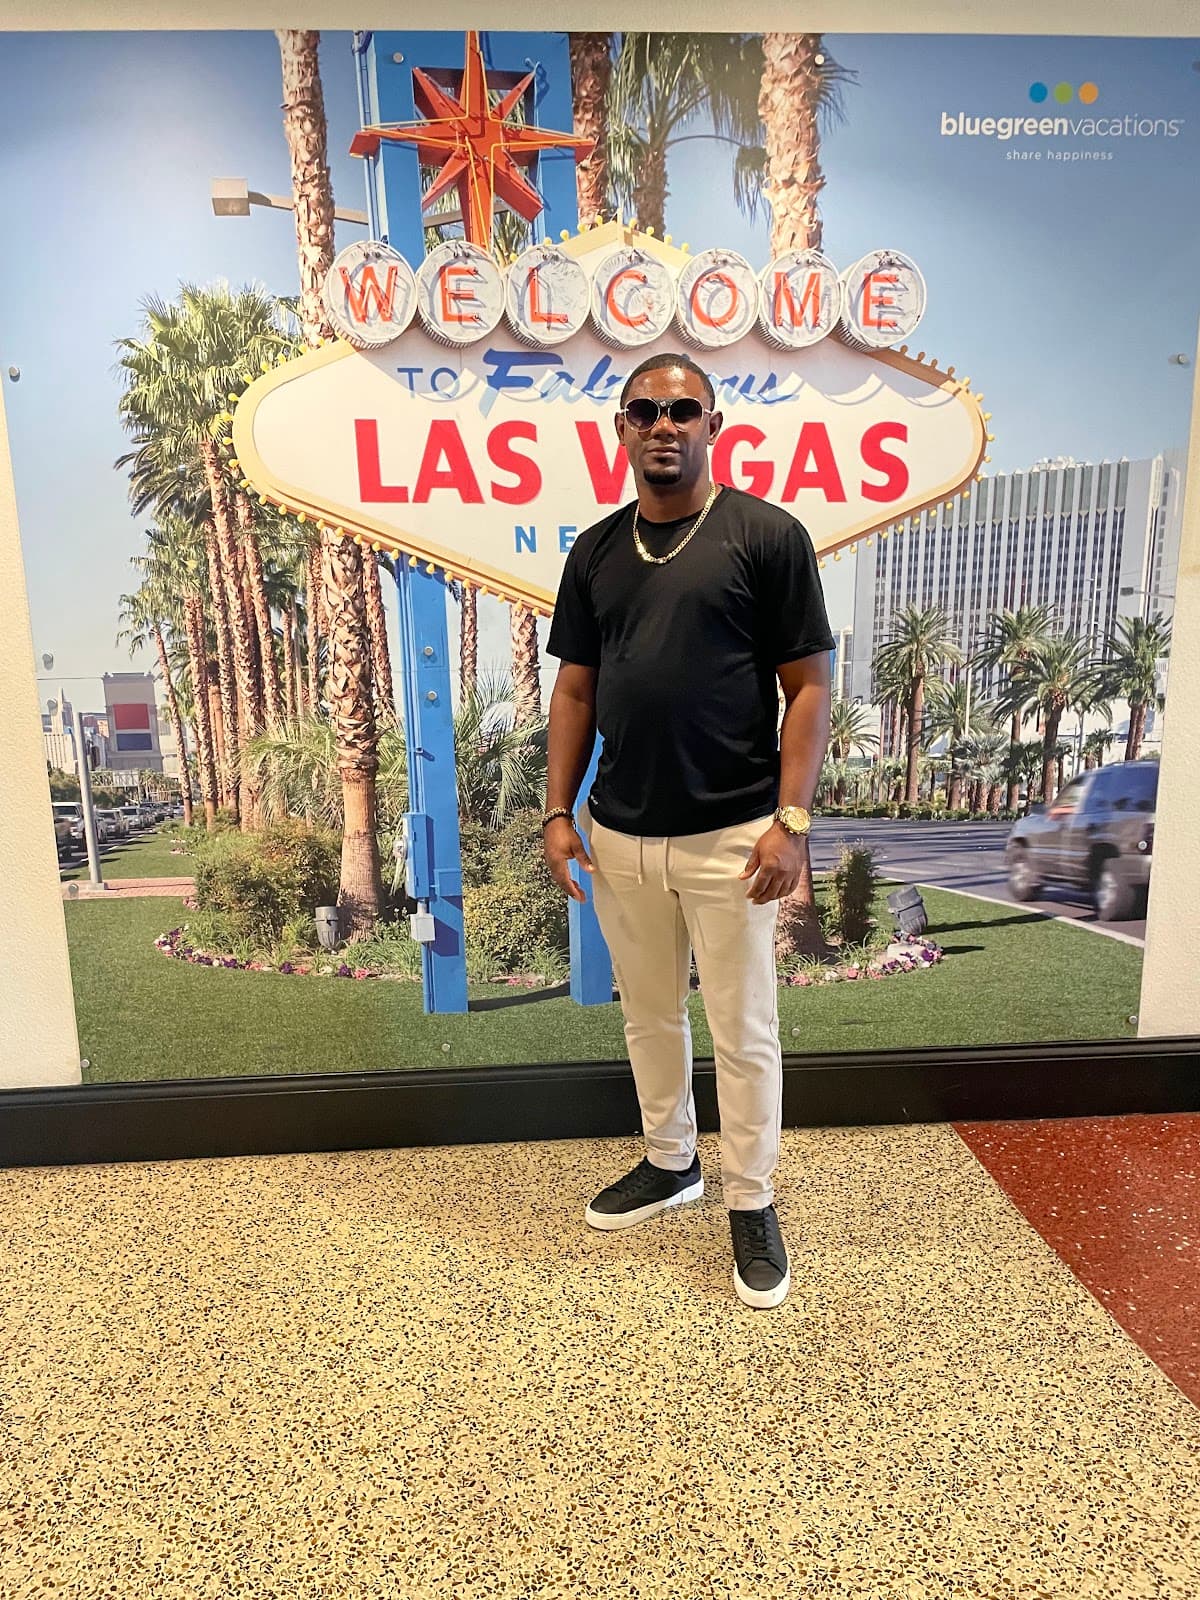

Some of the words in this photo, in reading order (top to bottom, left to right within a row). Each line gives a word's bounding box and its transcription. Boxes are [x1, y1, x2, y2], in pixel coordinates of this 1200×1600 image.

[940, 111, 1181, 139] bluegreenvacations
[1006, 150, 1042, 161] share
[1047, 150, 1113, 162] happiness
[338, 264, 900, 330] WELCOME
[397, 366, 459, 391] TO
[354, 418, 542, 505] LAS
[575, 420, 910, 504] VGAS
